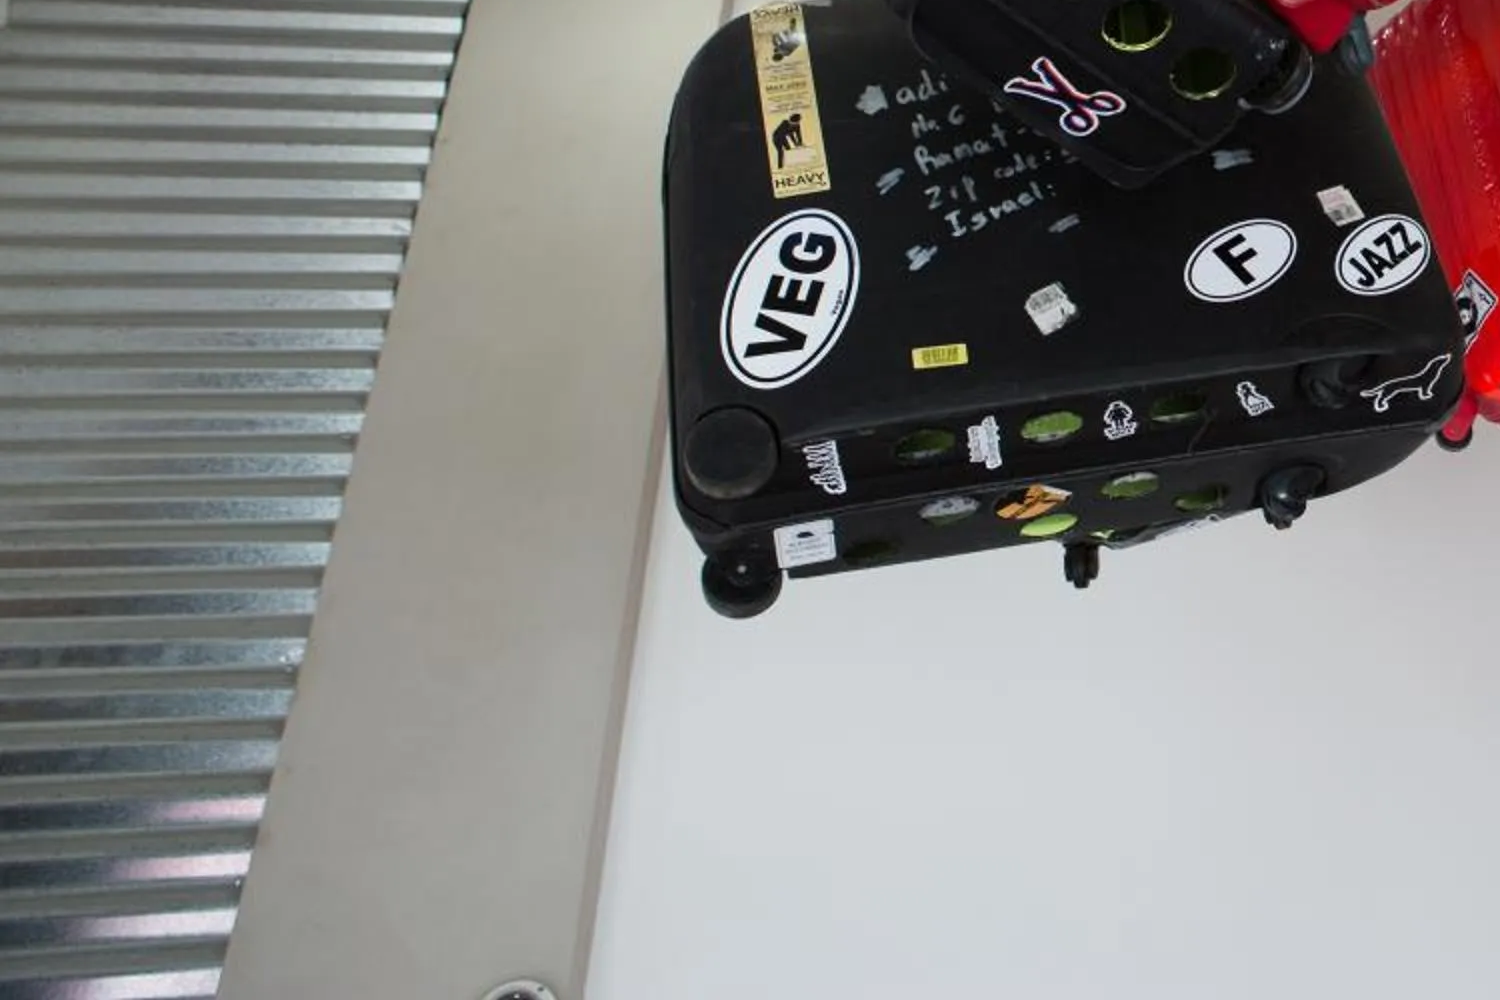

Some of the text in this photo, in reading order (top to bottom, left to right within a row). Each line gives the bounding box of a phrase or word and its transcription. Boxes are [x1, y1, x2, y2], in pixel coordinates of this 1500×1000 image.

[774, 172, 826, 189] HEAVY
[1213, 233, 1257, 286] F
[1348, 221, 1422, 287] JAZZ
[744, 232, 836, 358] VEG
